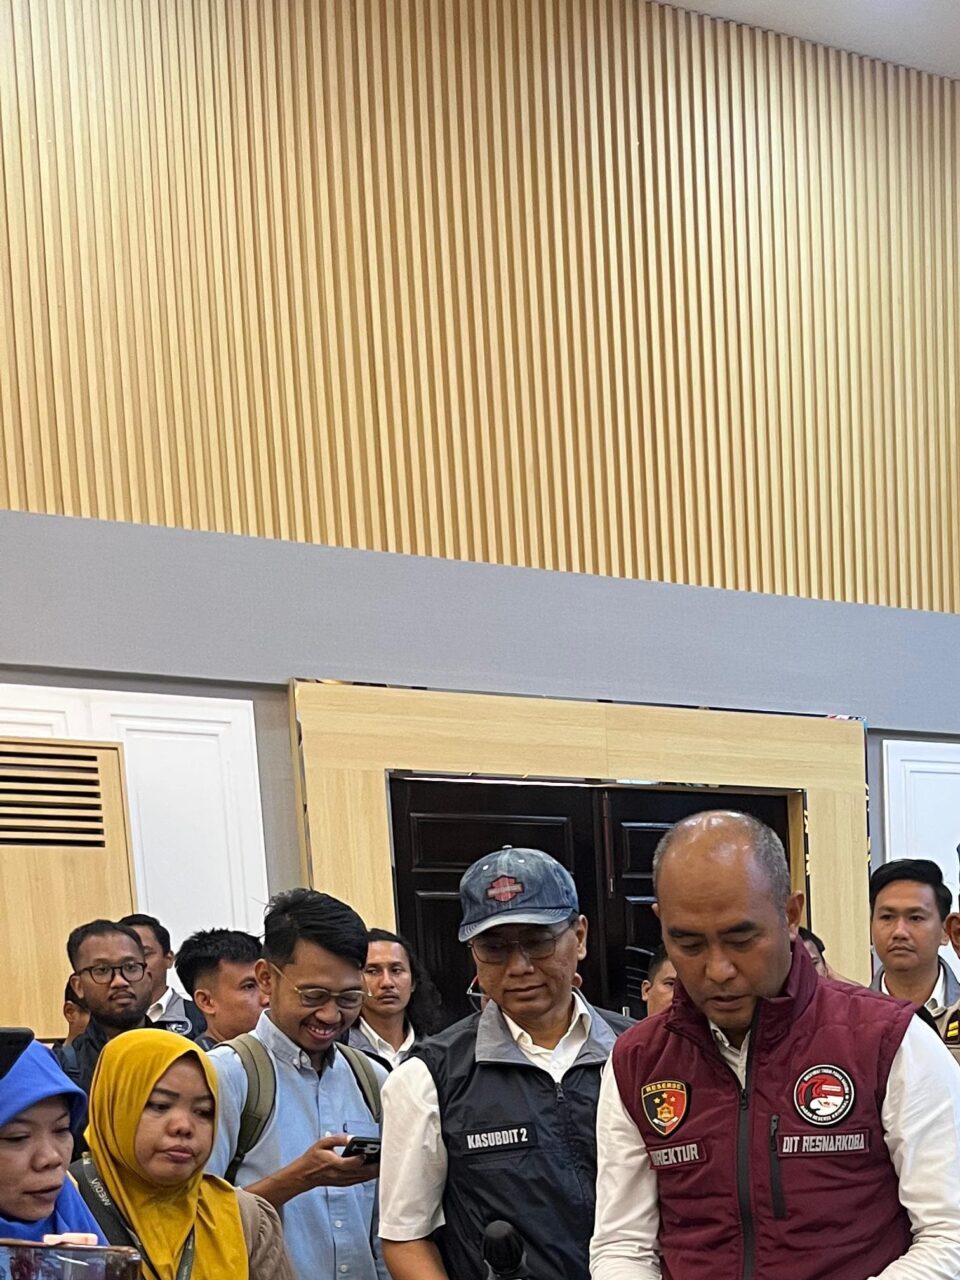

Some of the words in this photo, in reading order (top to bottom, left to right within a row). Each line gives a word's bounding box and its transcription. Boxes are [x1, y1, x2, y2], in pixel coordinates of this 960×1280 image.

[466, 1128, 519, 1149] KASUBDIT
[519, 1128, 529, 1142] 2
[782, 1136, 800, 1153] DIT
[802, 1134, 865, 1152] RESNARKOBA
